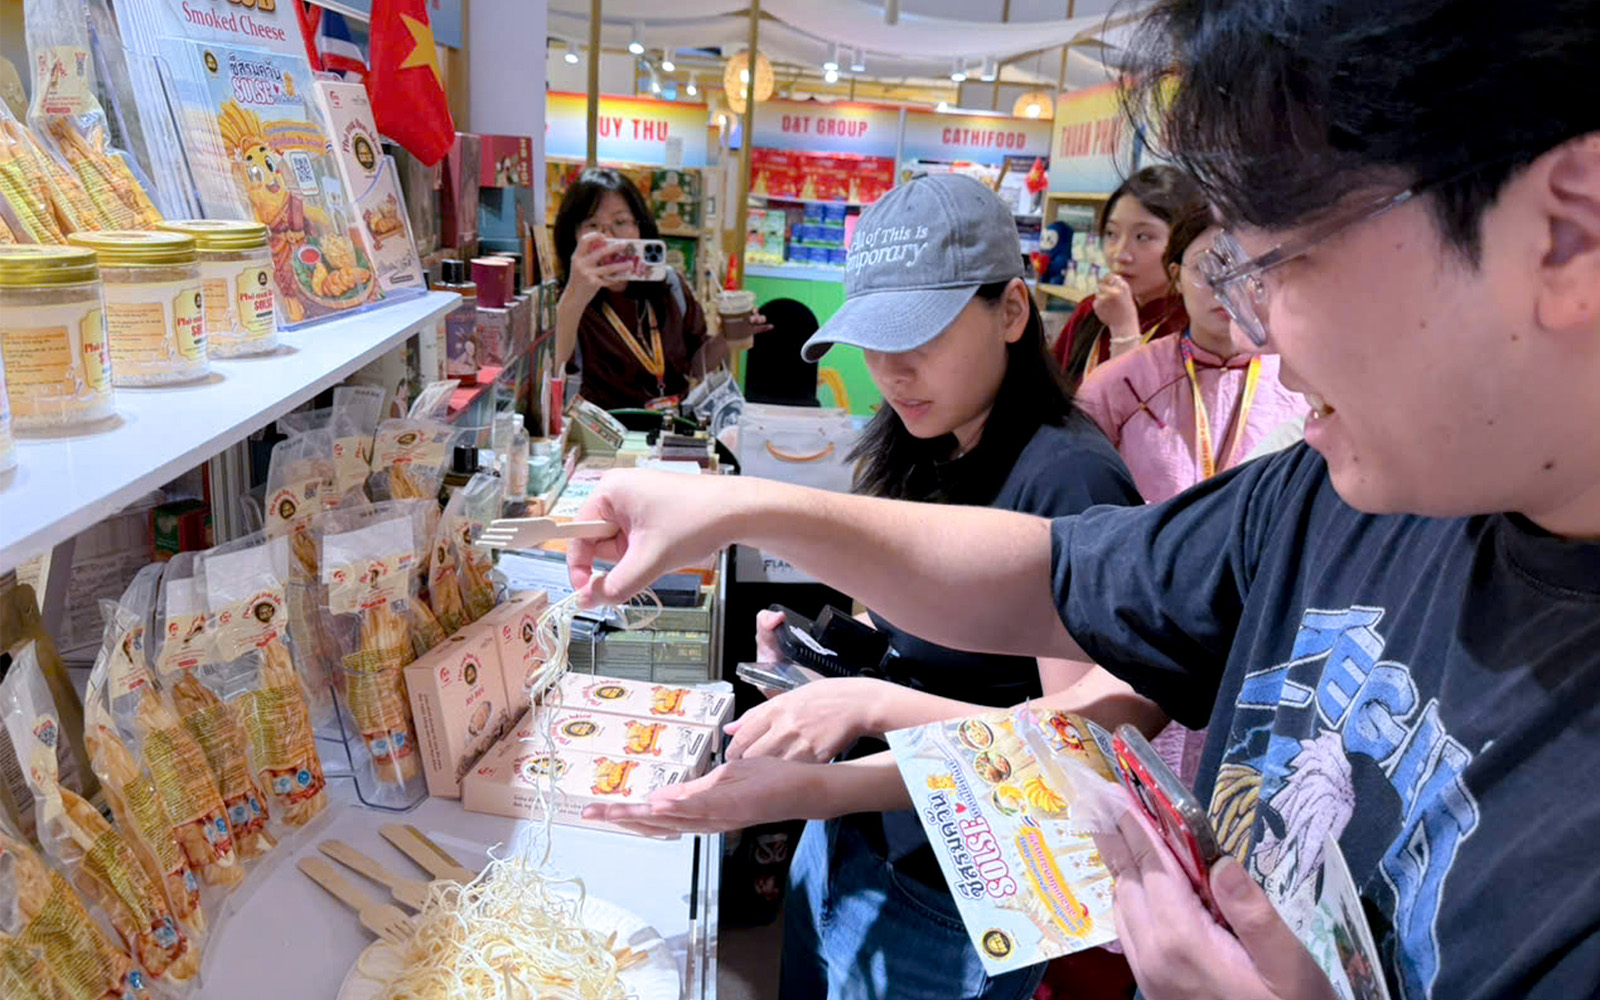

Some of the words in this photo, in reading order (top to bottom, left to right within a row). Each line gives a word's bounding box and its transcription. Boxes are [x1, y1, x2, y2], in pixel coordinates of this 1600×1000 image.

[182, 1, 238, 32] Smoked
[240, 15, 286, 41] Cheese
[632, 118, 668, 142] THU
[816, 117, 868, 138] GROUP
[942, 127, 1026, 150] CATHIFOOD
[865, 228, 882, 247] of
[881, 226, 911, 244] This
[926, 792, 985, 898] ชีสรมควัน
[958, 816, 1018, 898] SOLSE
